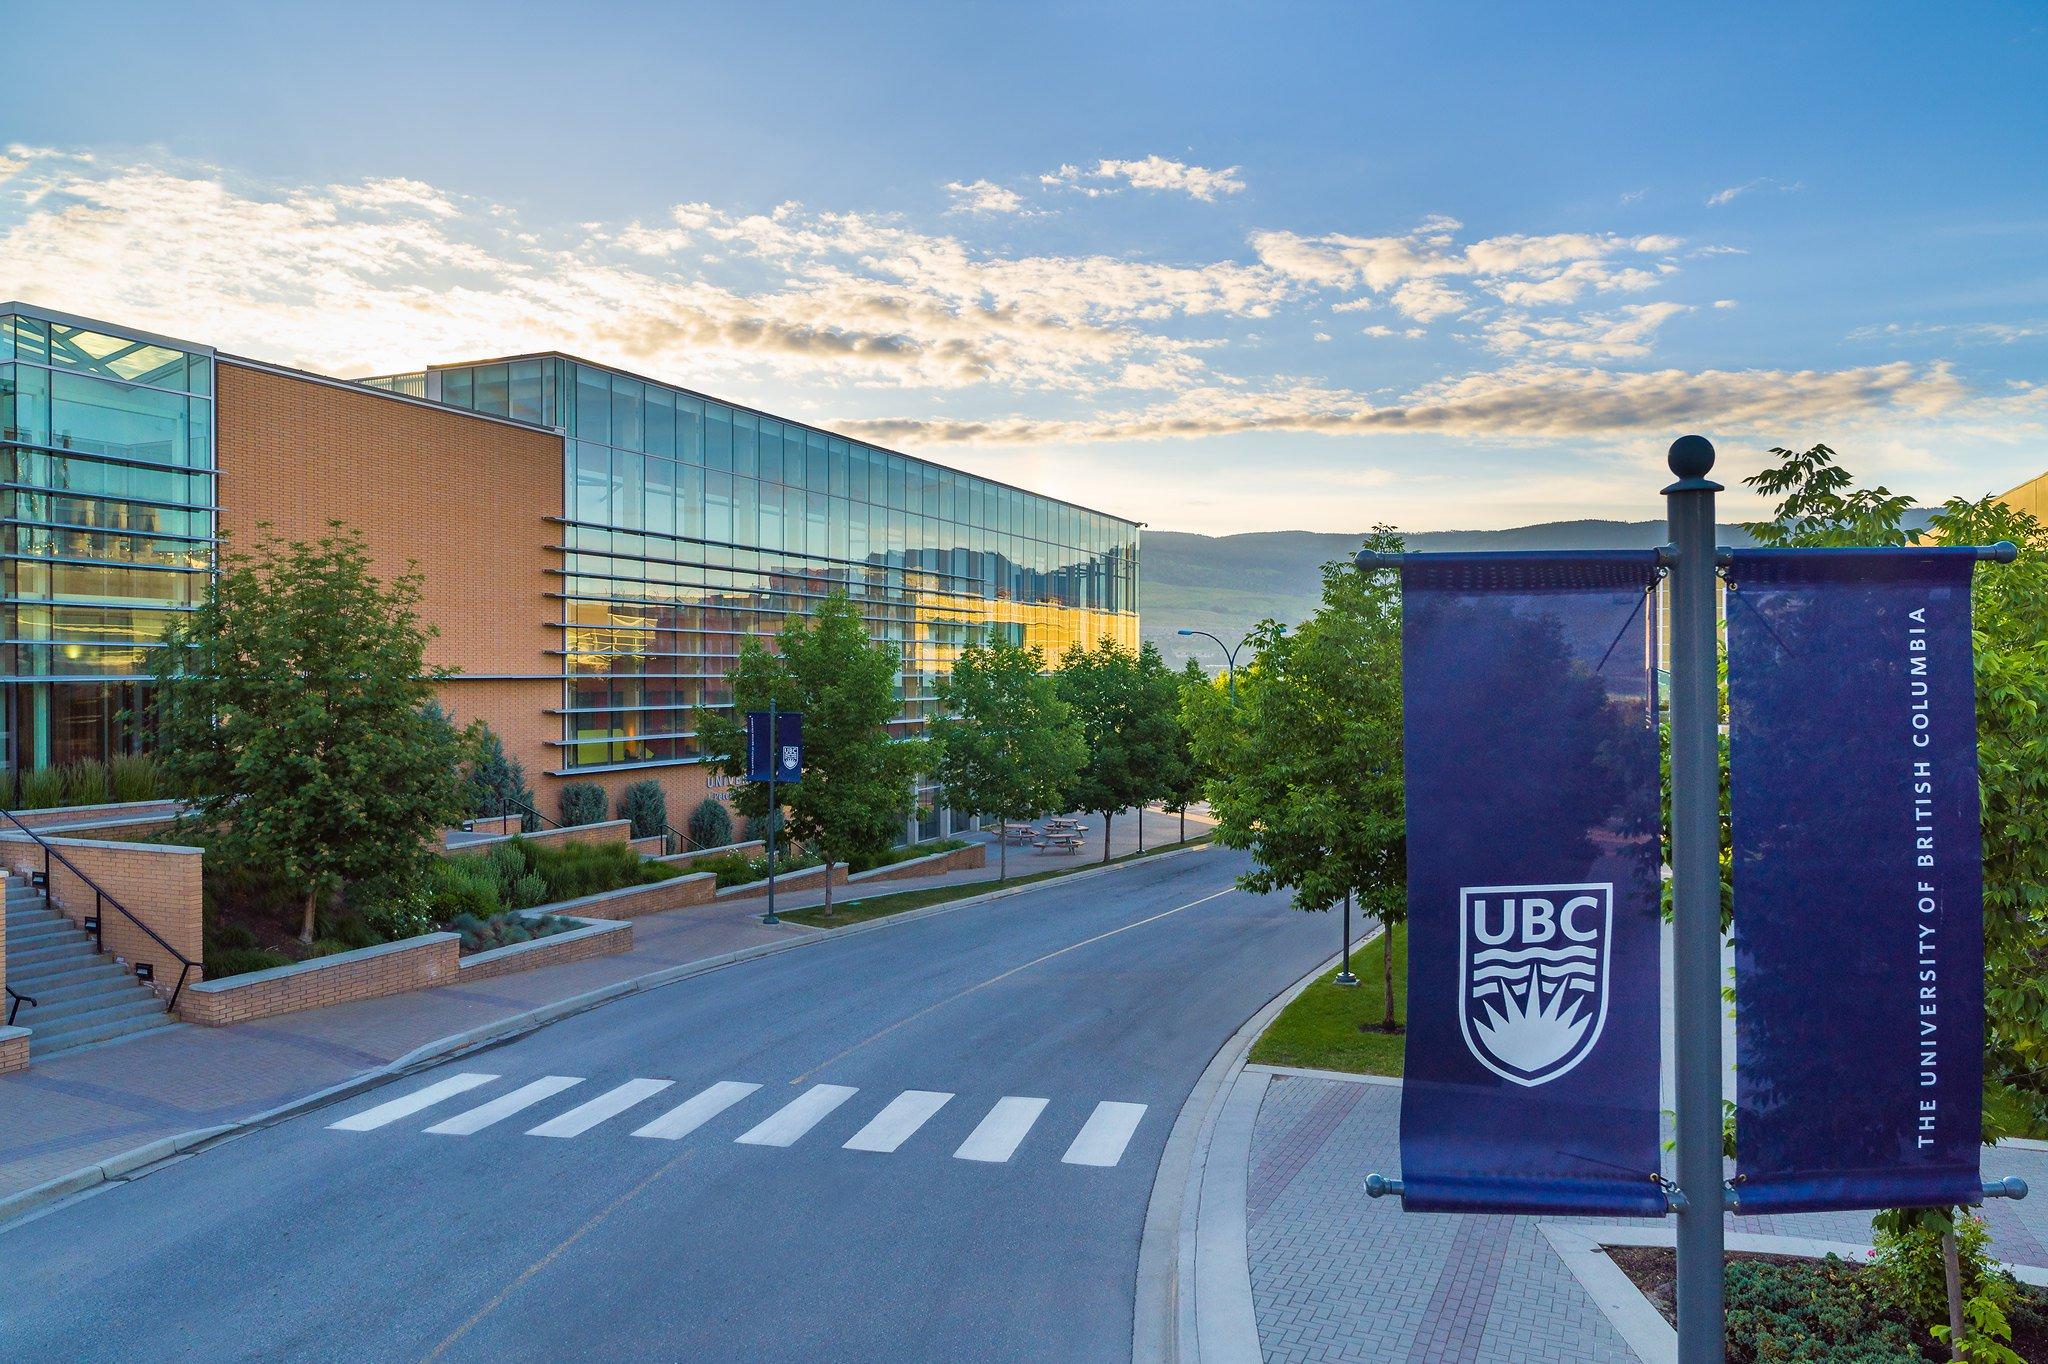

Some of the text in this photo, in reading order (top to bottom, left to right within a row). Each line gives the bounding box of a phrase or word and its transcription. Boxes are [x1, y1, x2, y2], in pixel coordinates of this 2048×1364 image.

[1474, 895, 1599, 945] UBC
[1908, 607, 1937, 1149] THE UNIVERSITY OF BRITISH COLUMBIA
